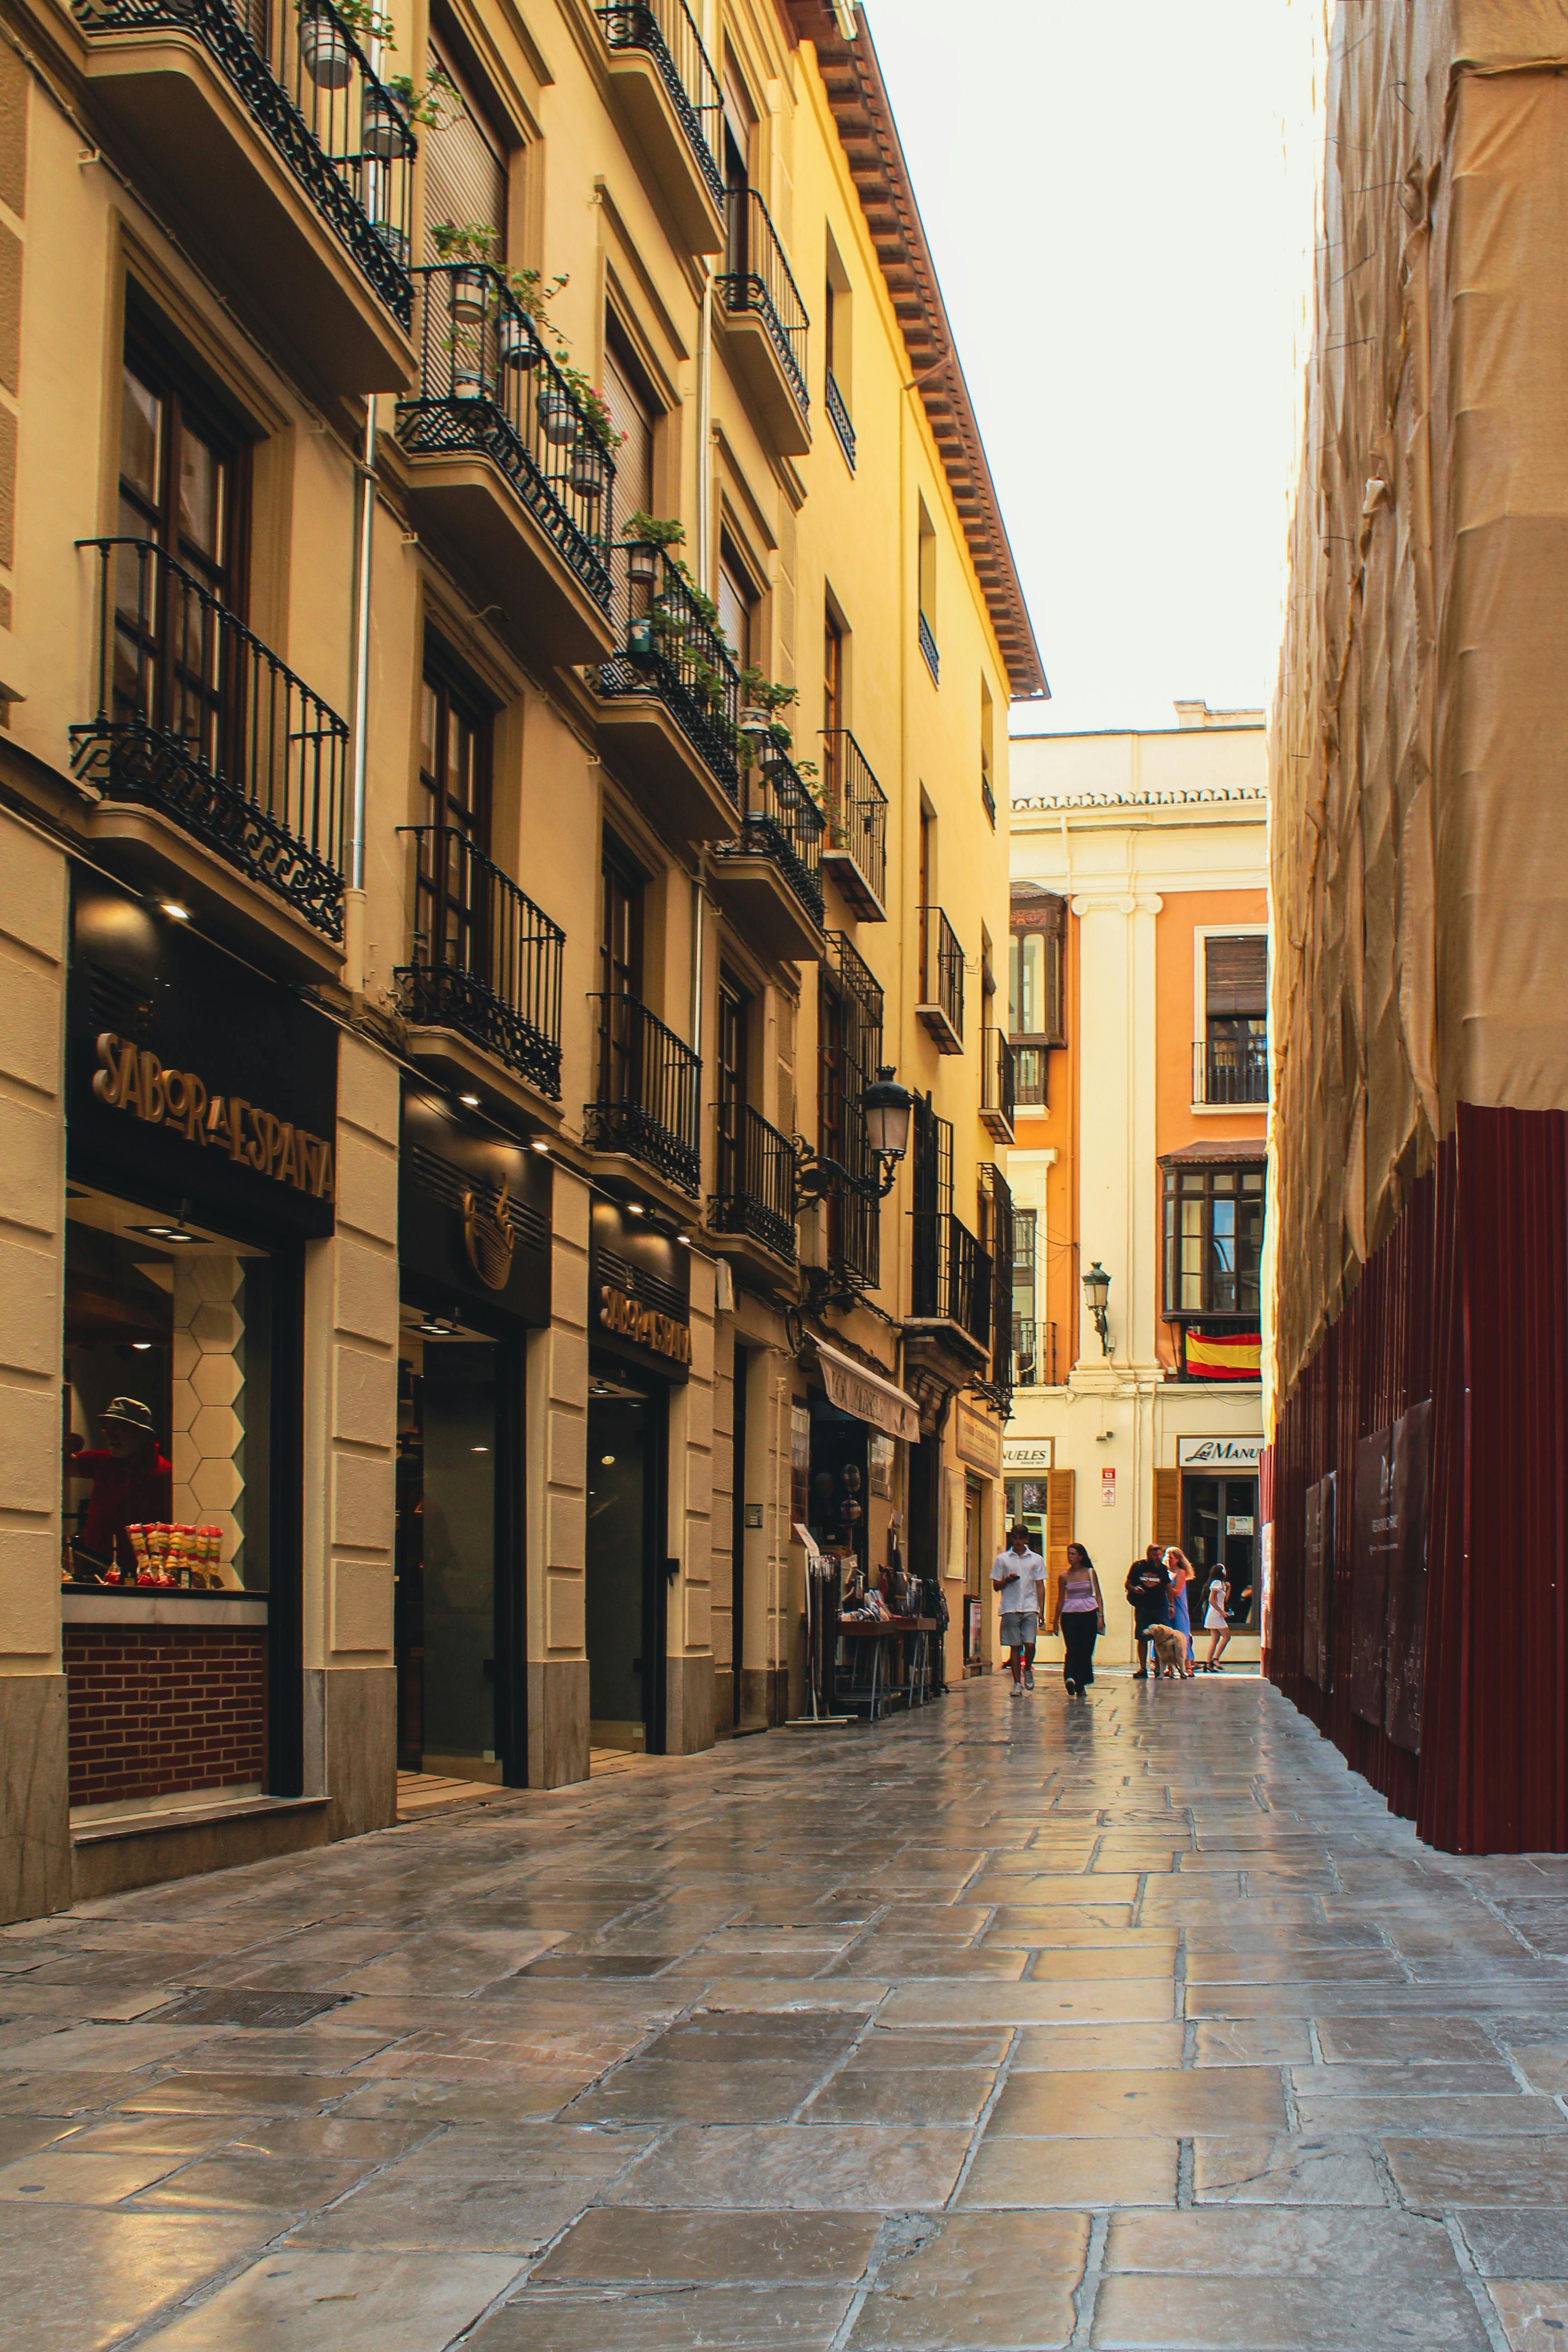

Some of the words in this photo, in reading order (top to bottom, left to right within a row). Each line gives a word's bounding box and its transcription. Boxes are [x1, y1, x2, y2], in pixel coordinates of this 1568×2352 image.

[93, 1033, 207, 1146] SABOR
[207, 1096, 231, 1149] A
[230, 1097, 336, 1203] ESPAÑA
[600, 1286, 643, 1343] SABOR
[649, 1309, 692, 1366] ESPAÑA
